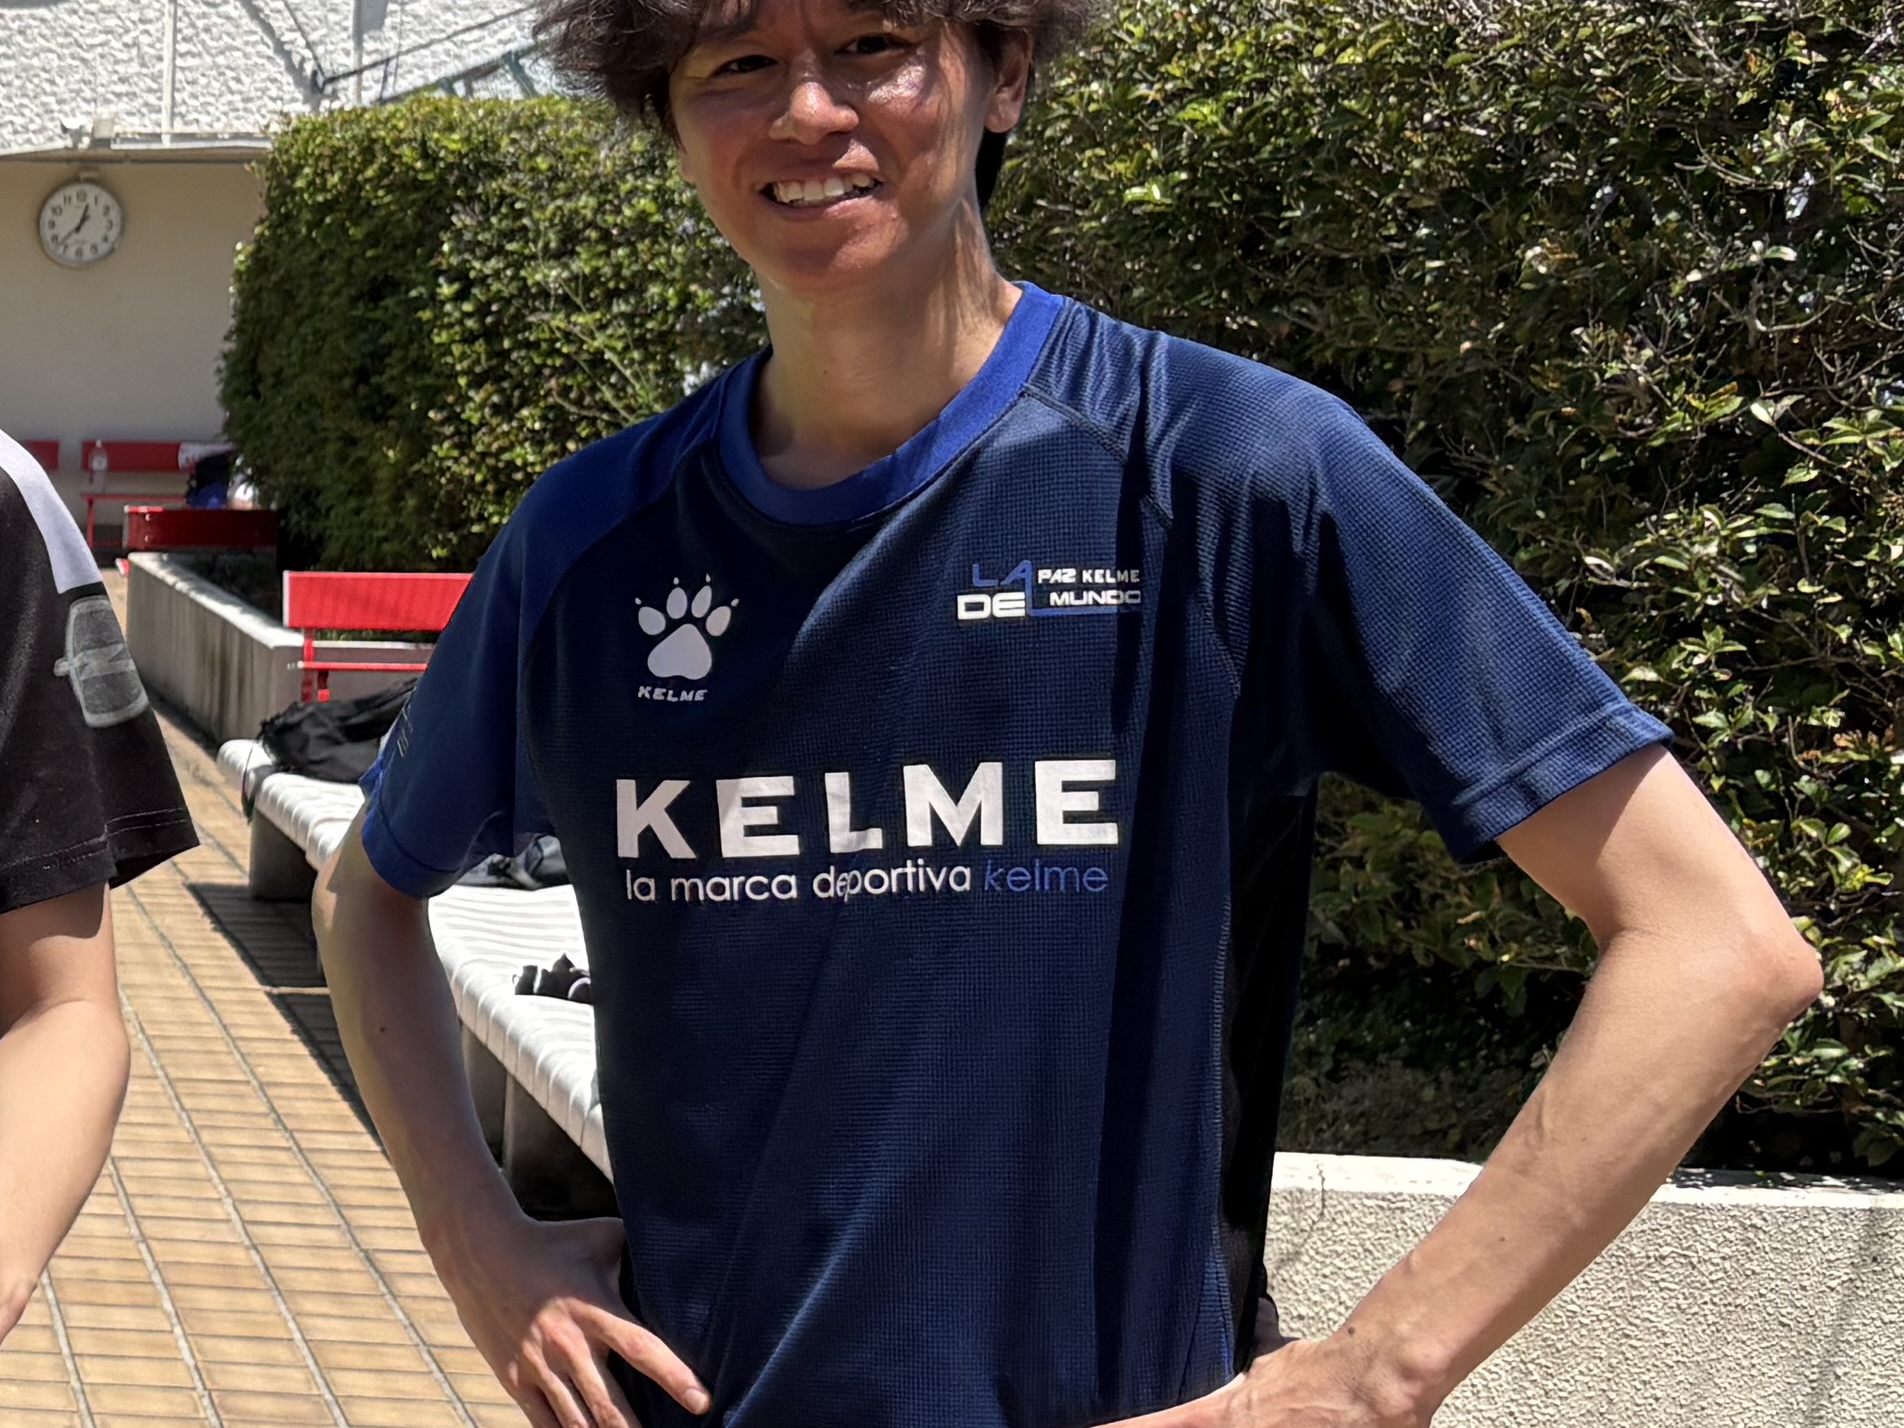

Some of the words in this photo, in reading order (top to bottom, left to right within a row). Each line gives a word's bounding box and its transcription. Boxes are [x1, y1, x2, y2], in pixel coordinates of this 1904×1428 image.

[1037, 568, 1077, 584] PAZ
[1082, 569, 1140, 584] KELME
[1049, 589, 1142, 607] MUNDO
[638, 685, 709, 703] KELME
[616, 760, 1119, 859] KELME
[626, 869, 656, 902] la
[671, 872, 798, 903] marca
[812, 860, 971, 906] deportiva
[983, 858, 1110, 893] kelme
